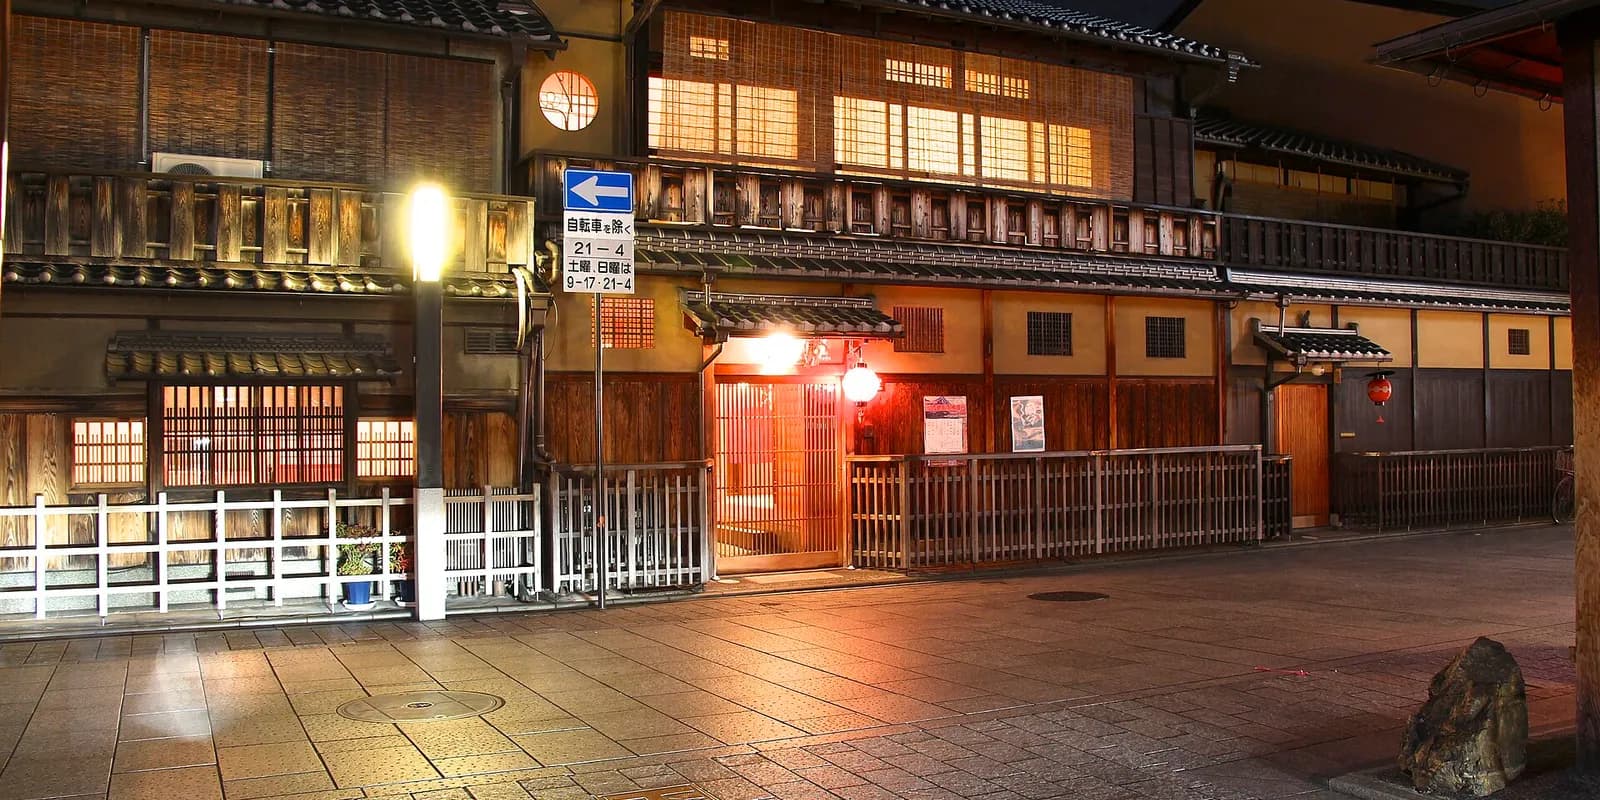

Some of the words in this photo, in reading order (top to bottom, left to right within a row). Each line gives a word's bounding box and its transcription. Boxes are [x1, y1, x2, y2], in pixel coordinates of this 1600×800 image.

[567, 217, 631, 235] 自転車を除く
